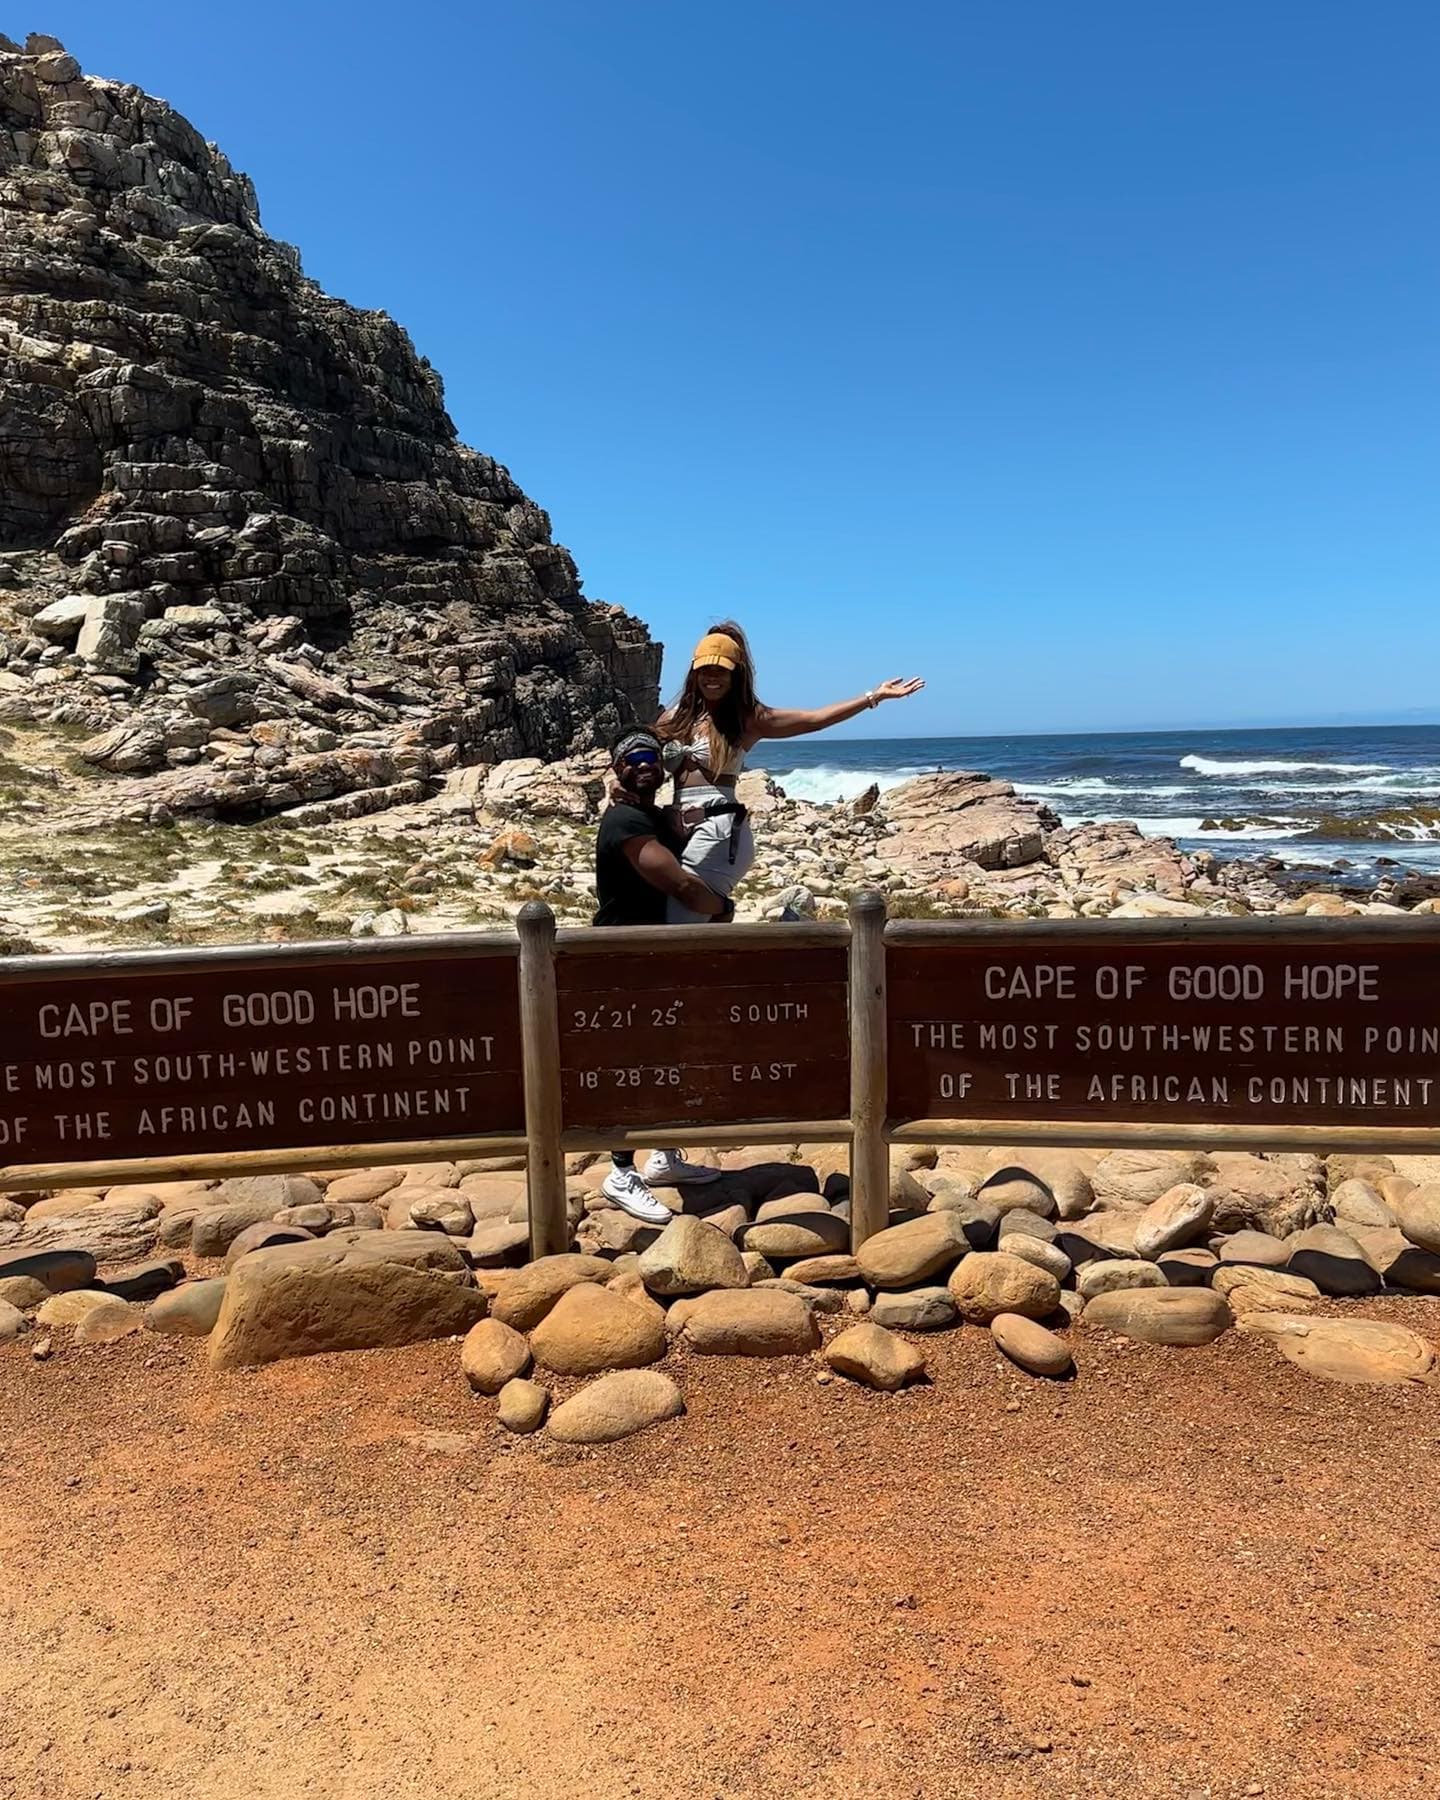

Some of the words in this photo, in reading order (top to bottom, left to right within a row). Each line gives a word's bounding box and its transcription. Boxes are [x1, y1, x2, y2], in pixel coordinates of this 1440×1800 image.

[984, 965, 1076, 1000] CAPE
[1095, 965, 1145, 1000] OF
[1168, 964, 1264, 1001] GOOD
[1284, 964, 1380, 1001] HOPE
[38, 1000, 134, 1038] CAPE
[150, 997, 195, 1032] OF
[223, 990, 315, 1026] GOOD
[333, 983, 421, 1020] HOPE
[729, 1002, 809, 1023] SOUTH
[911, 1024, 964, 1050] THE
[979, 1024, 1059, 1051] MOST
[1075, 1025, 1344, 1053] SOUTH-WESTERN
[35, 1060, 116, 1090] MOST
[133, 1042, 394, 1084] SOUTH-WESTERN
[408, 1036, 494, 1069] POINT
[732, 1062, 798, 1082] EAST
[939, 1072, 973, 1099] OF
[1004, 1072, 1061, 1100] THE
[1087, 1074, 1229, 1104] AFRICAN
[1248, 1076, 1434, 1106] CONTINENT
[54, 1111, 111, 1139] THE
[138, 1100, 275, 1135] AFRICAN
[299, 1087, 470, 1122] CONTINENT
